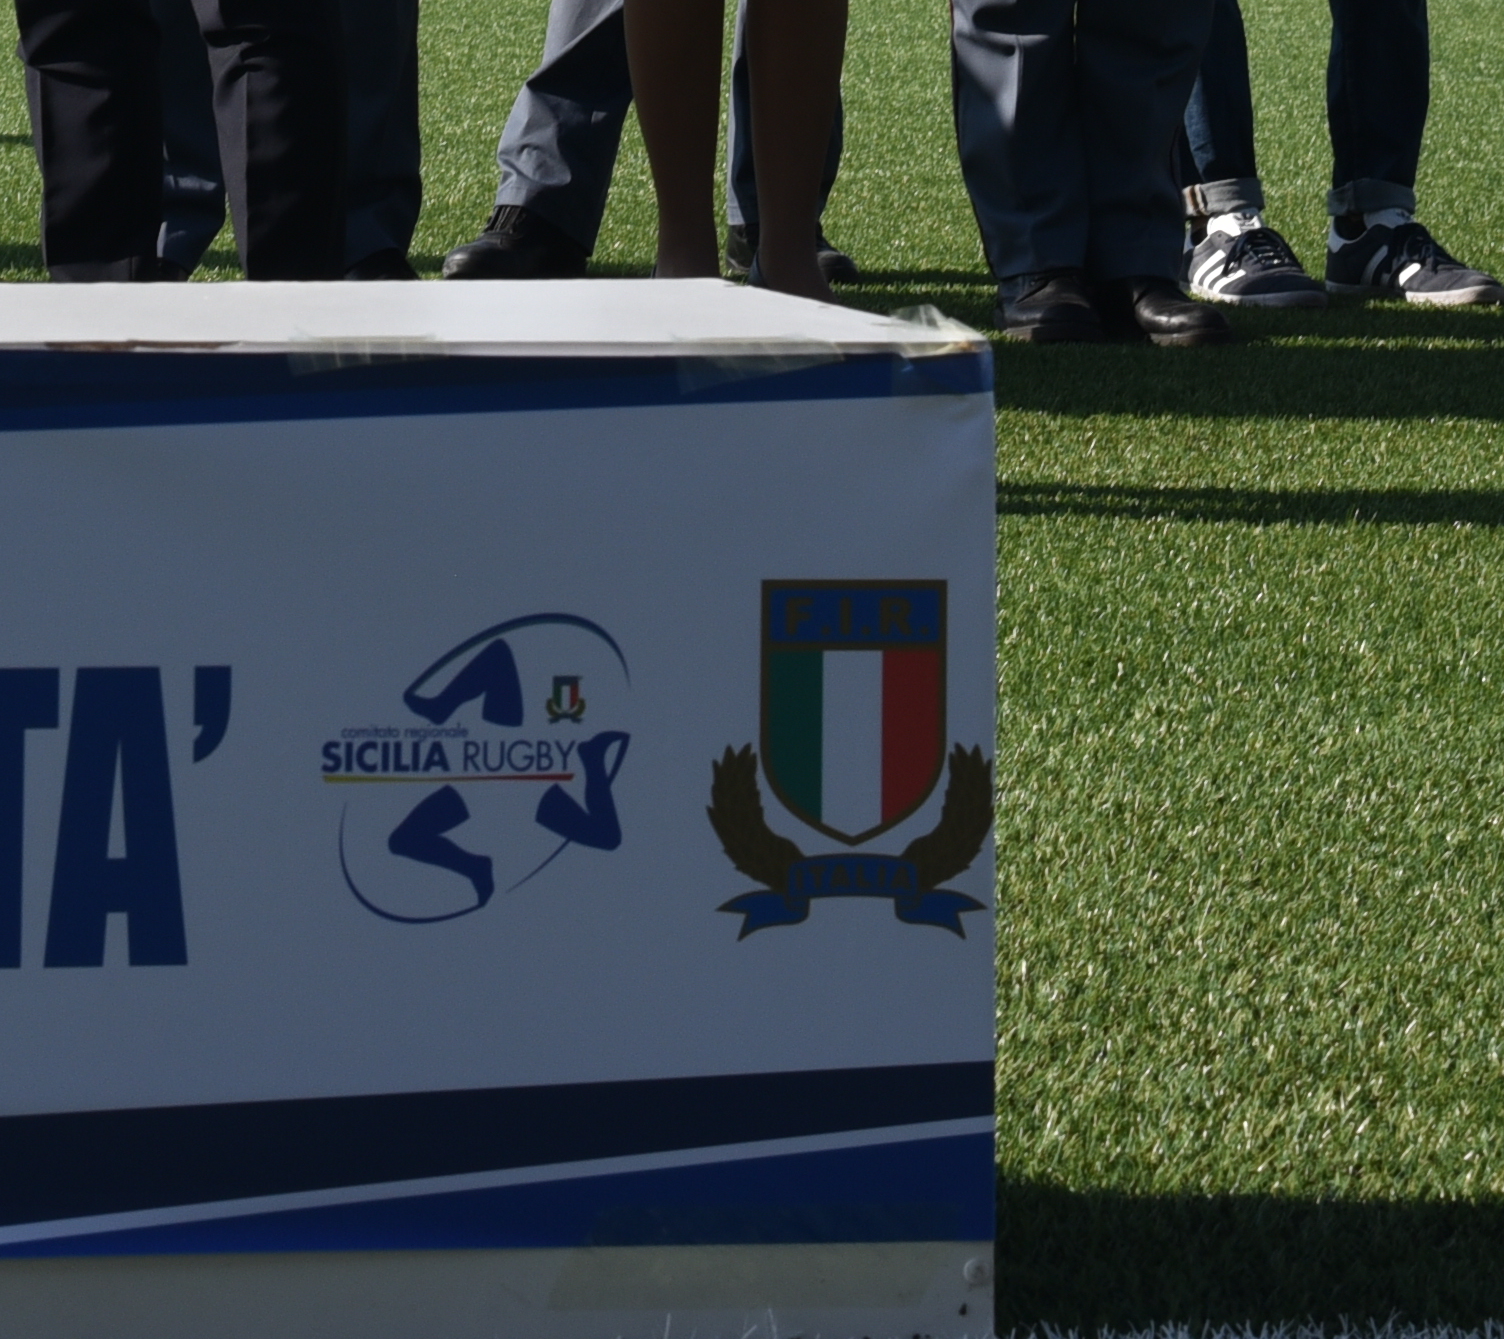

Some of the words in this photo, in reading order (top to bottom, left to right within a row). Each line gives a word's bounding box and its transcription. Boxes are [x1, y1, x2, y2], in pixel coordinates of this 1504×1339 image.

[785, 596, 930, 635] F.I.R.
[340, 724, 401, 739] comitato
[404, 723, 470, 742] regionale
[321, 740, 451, 773] SICILIA
[462, 739, 576, 772] RUGBY
[795, 862, 912, 891] ITALIA
